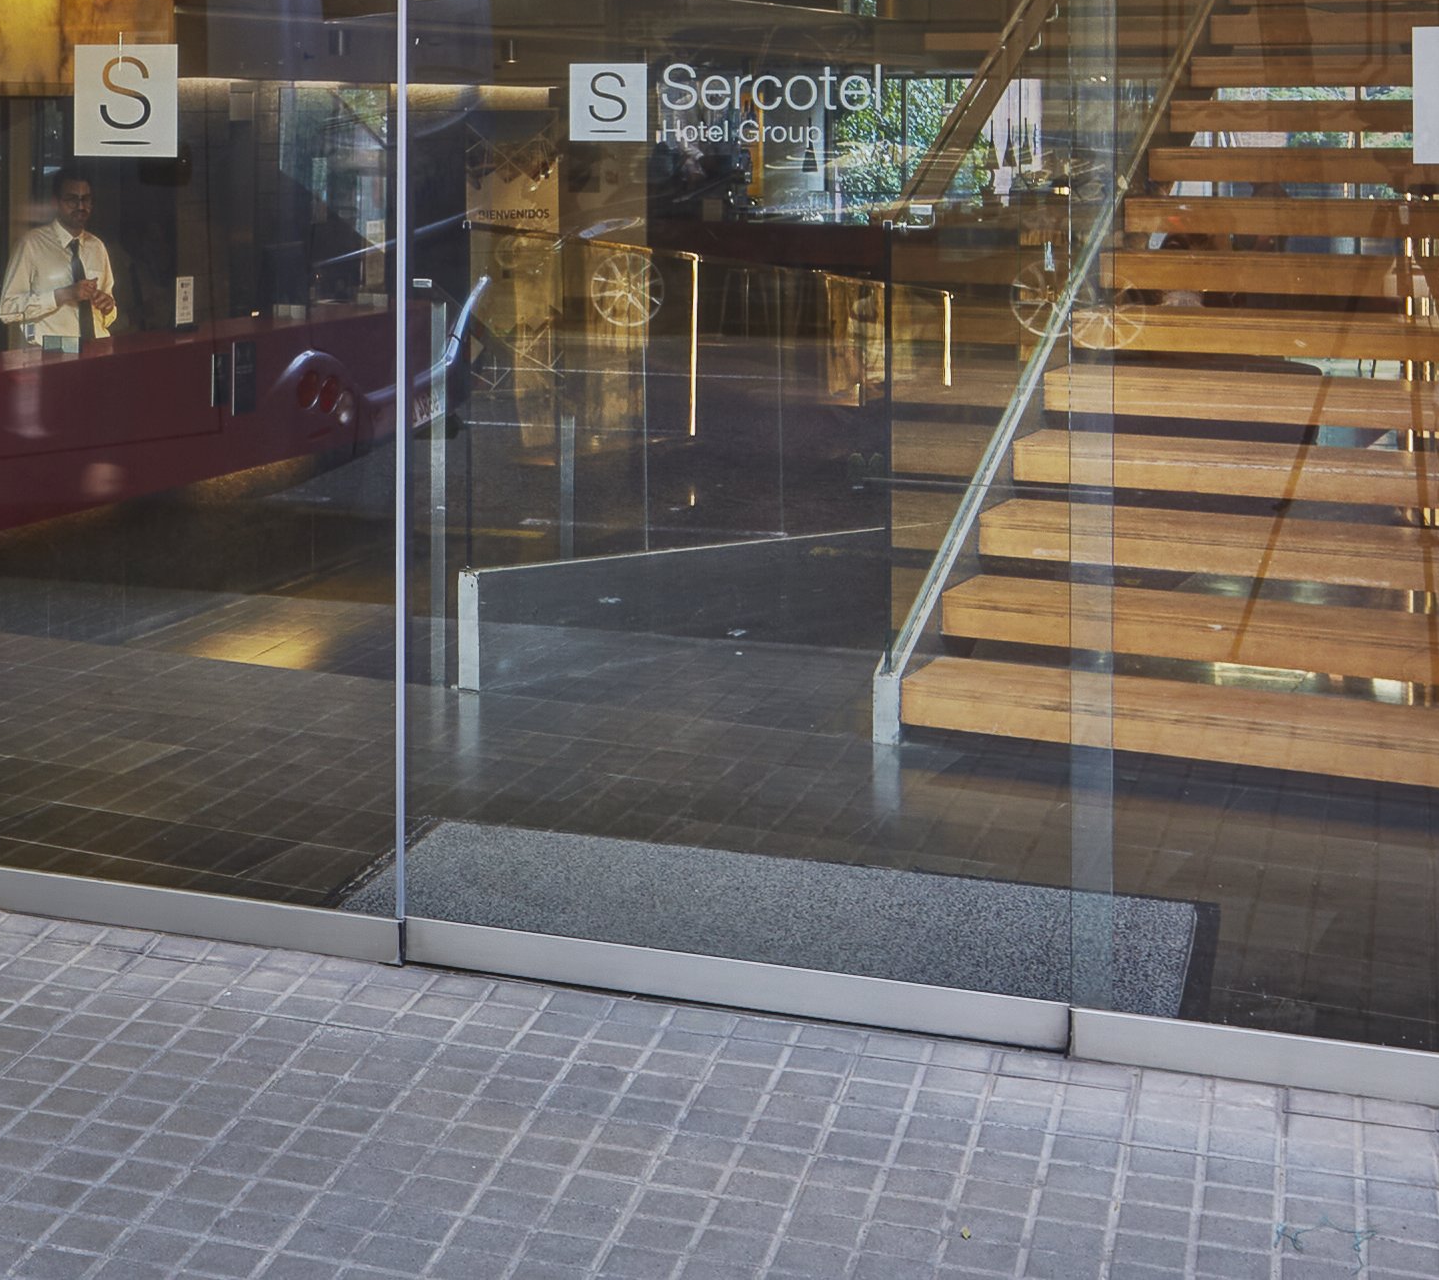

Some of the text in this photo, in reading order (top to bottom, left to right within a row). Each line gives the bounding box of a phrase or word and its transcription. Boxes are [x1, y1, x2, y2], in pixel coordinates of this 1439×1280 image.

[100, 56, 151, 130] S
[589, 71, 628, 123] S
[662, 63, 882, 111] Sercotel
[662, 120, 821, 149] Hotel Group
[478, 208, 550, 221] BIENVENIDOS
